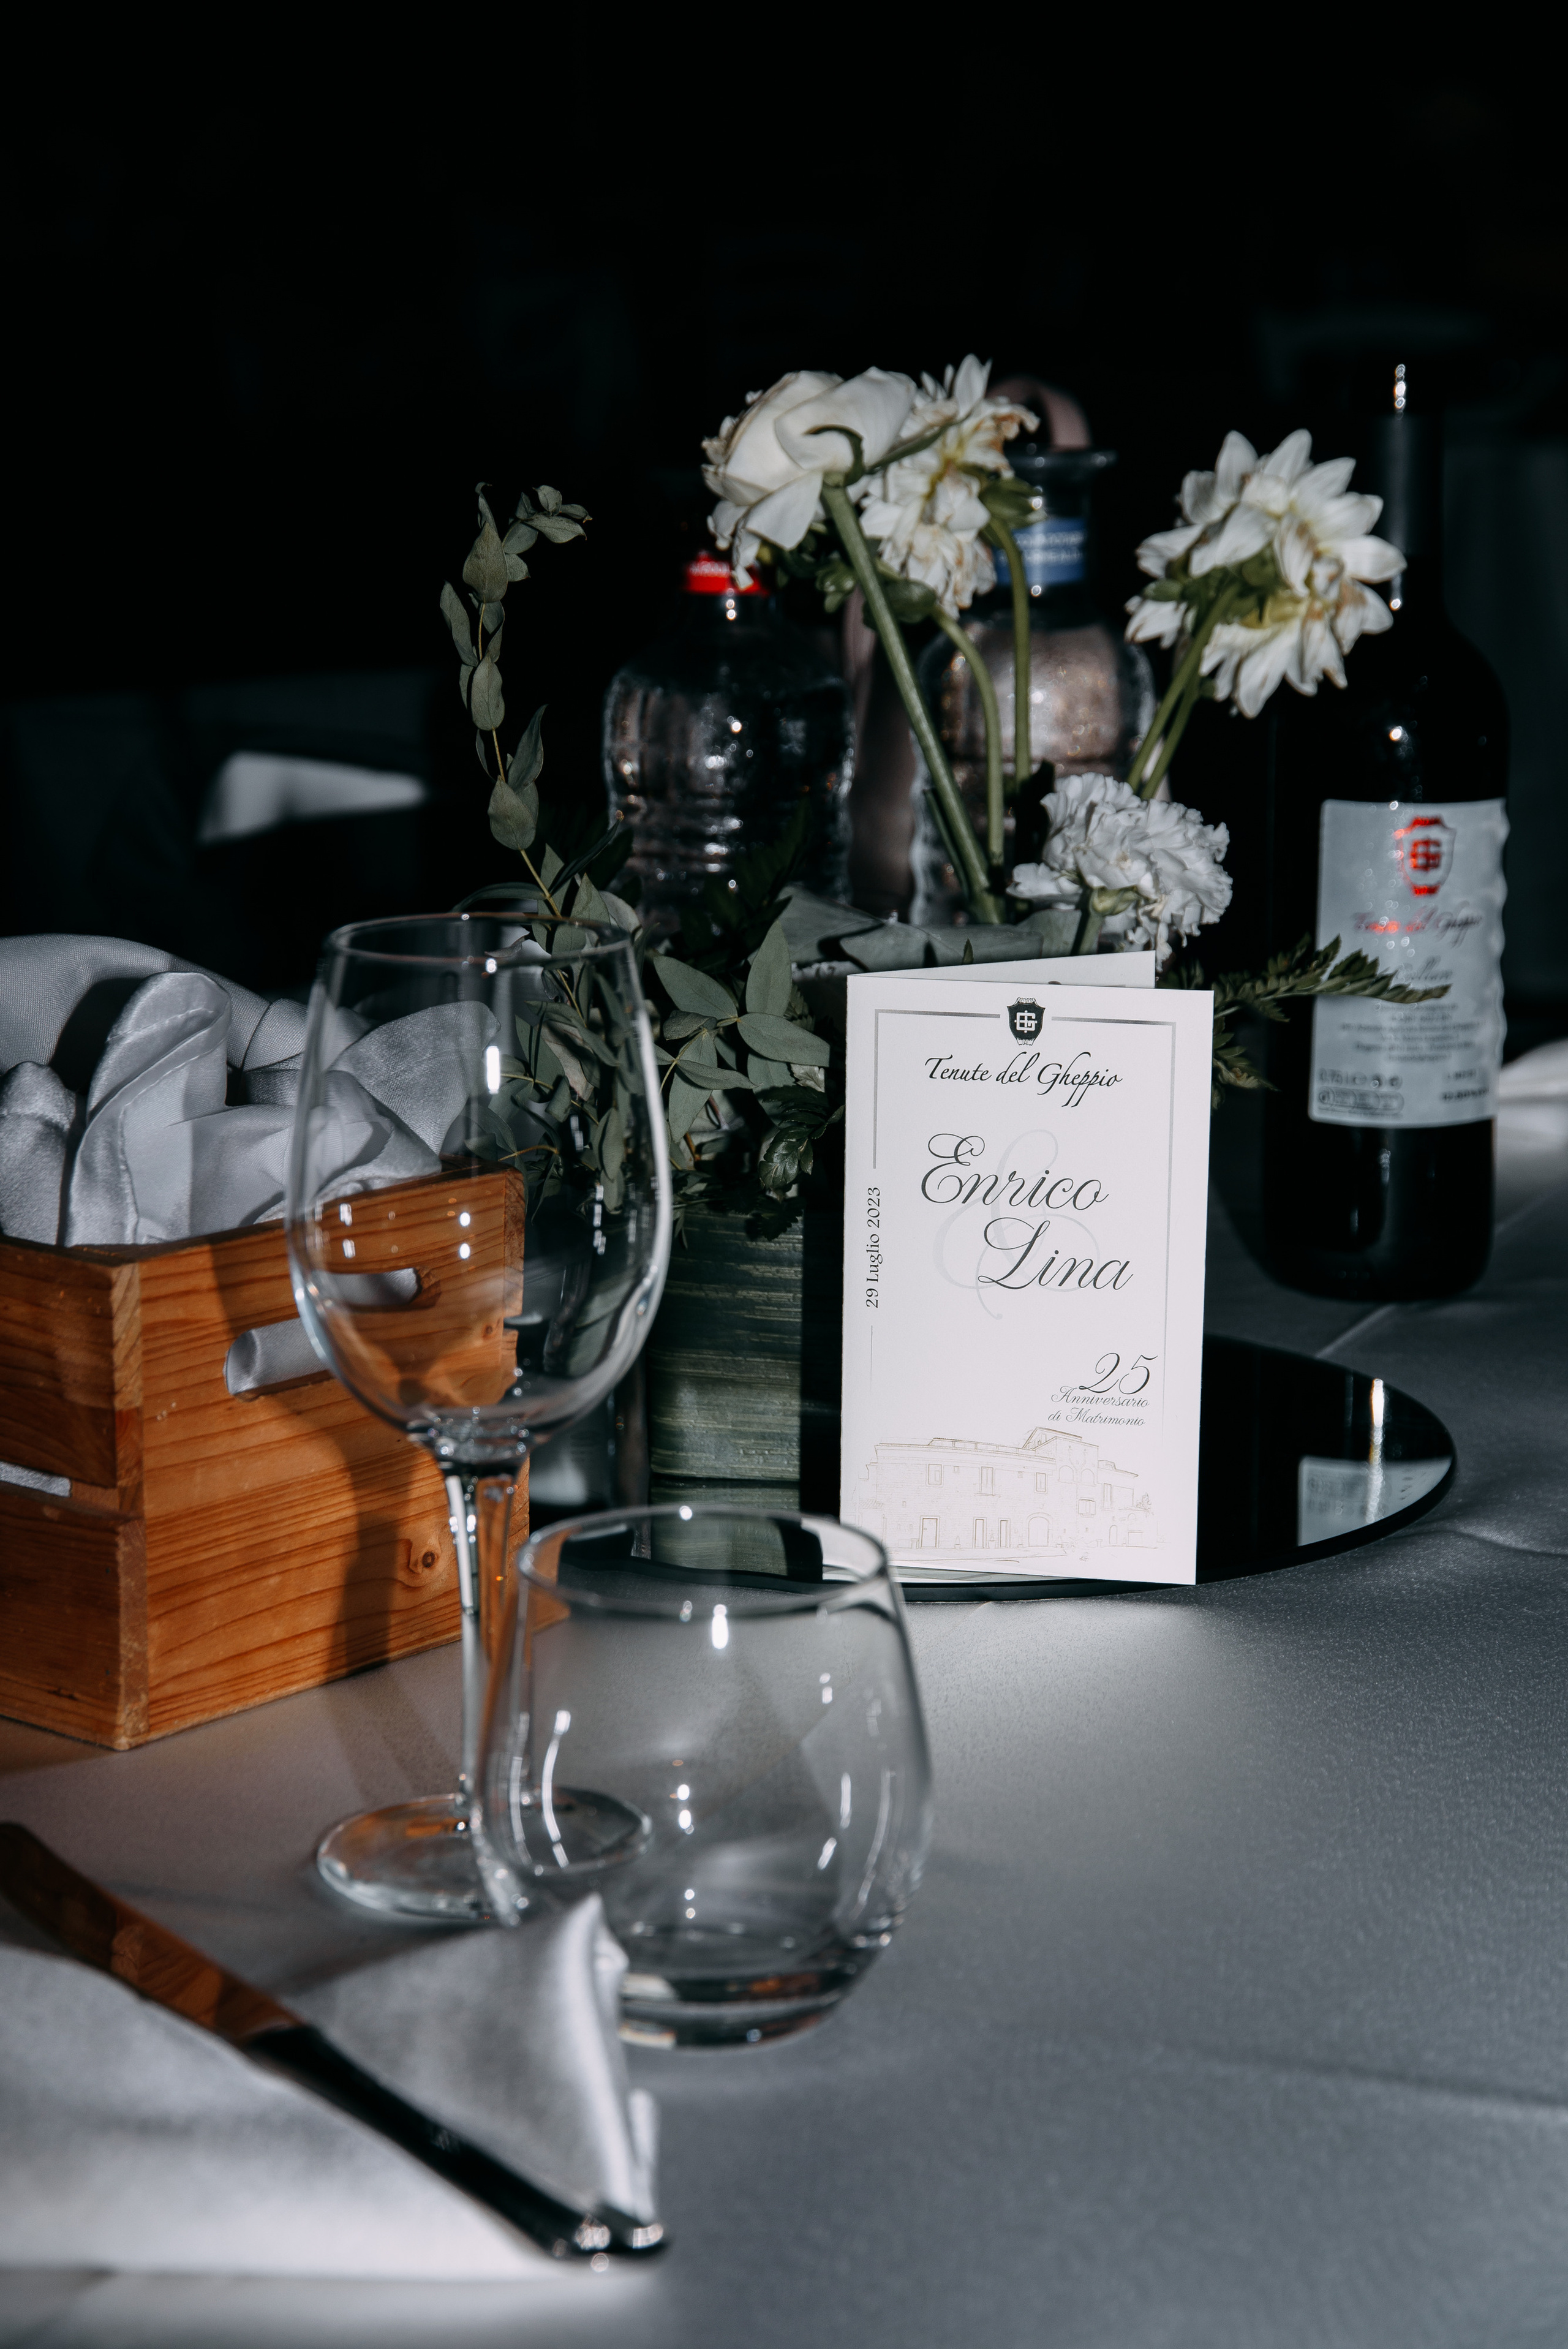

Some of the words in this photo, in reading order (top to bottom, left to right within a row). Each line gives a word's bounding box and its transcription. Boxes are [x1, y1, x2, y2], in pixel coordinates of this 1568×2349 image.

[925, 1054, 992, 1082] Tenute
[995, 1051, 1041, 1084] del
[1037, 1051, 1123, 1107] Gheppio
[921, 1133, 1109, 1210] Enrico
[867, 1187, 880, 1229] 2023
[865, 1234, 883, 1283] Luglio
[978, 1217, 1134, 1290] Lina
[865, 1288, 879, 1308] 29
[1079, 1352, 1158, 1395] 25
[1047, 1410, 1062, 1421] di
[1066, 1407, 1145, 1426] Matrimonio
[1051, 1386, 1150, 1408] Anniversario
